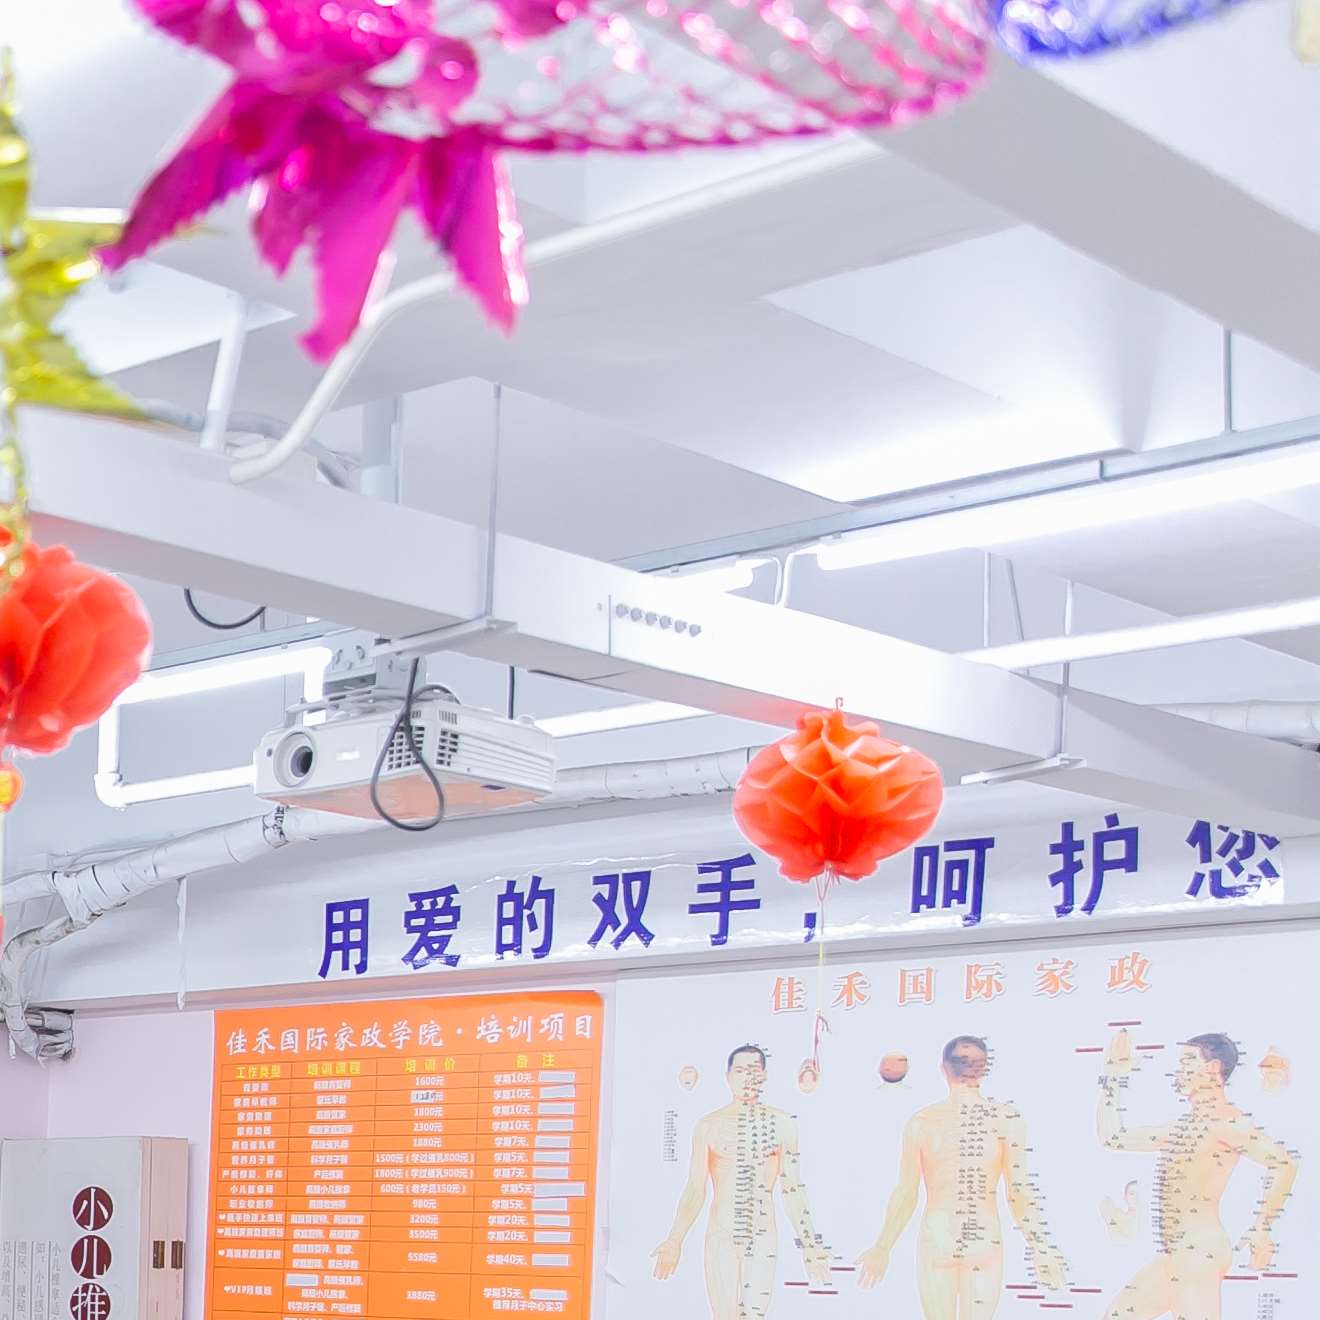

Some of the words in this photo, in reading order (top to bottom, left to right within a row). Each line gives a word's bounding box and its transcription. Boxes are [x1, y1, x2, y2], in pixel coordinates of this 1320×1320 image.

[770, 951, 1154, 1014] 佳禾国际家政
